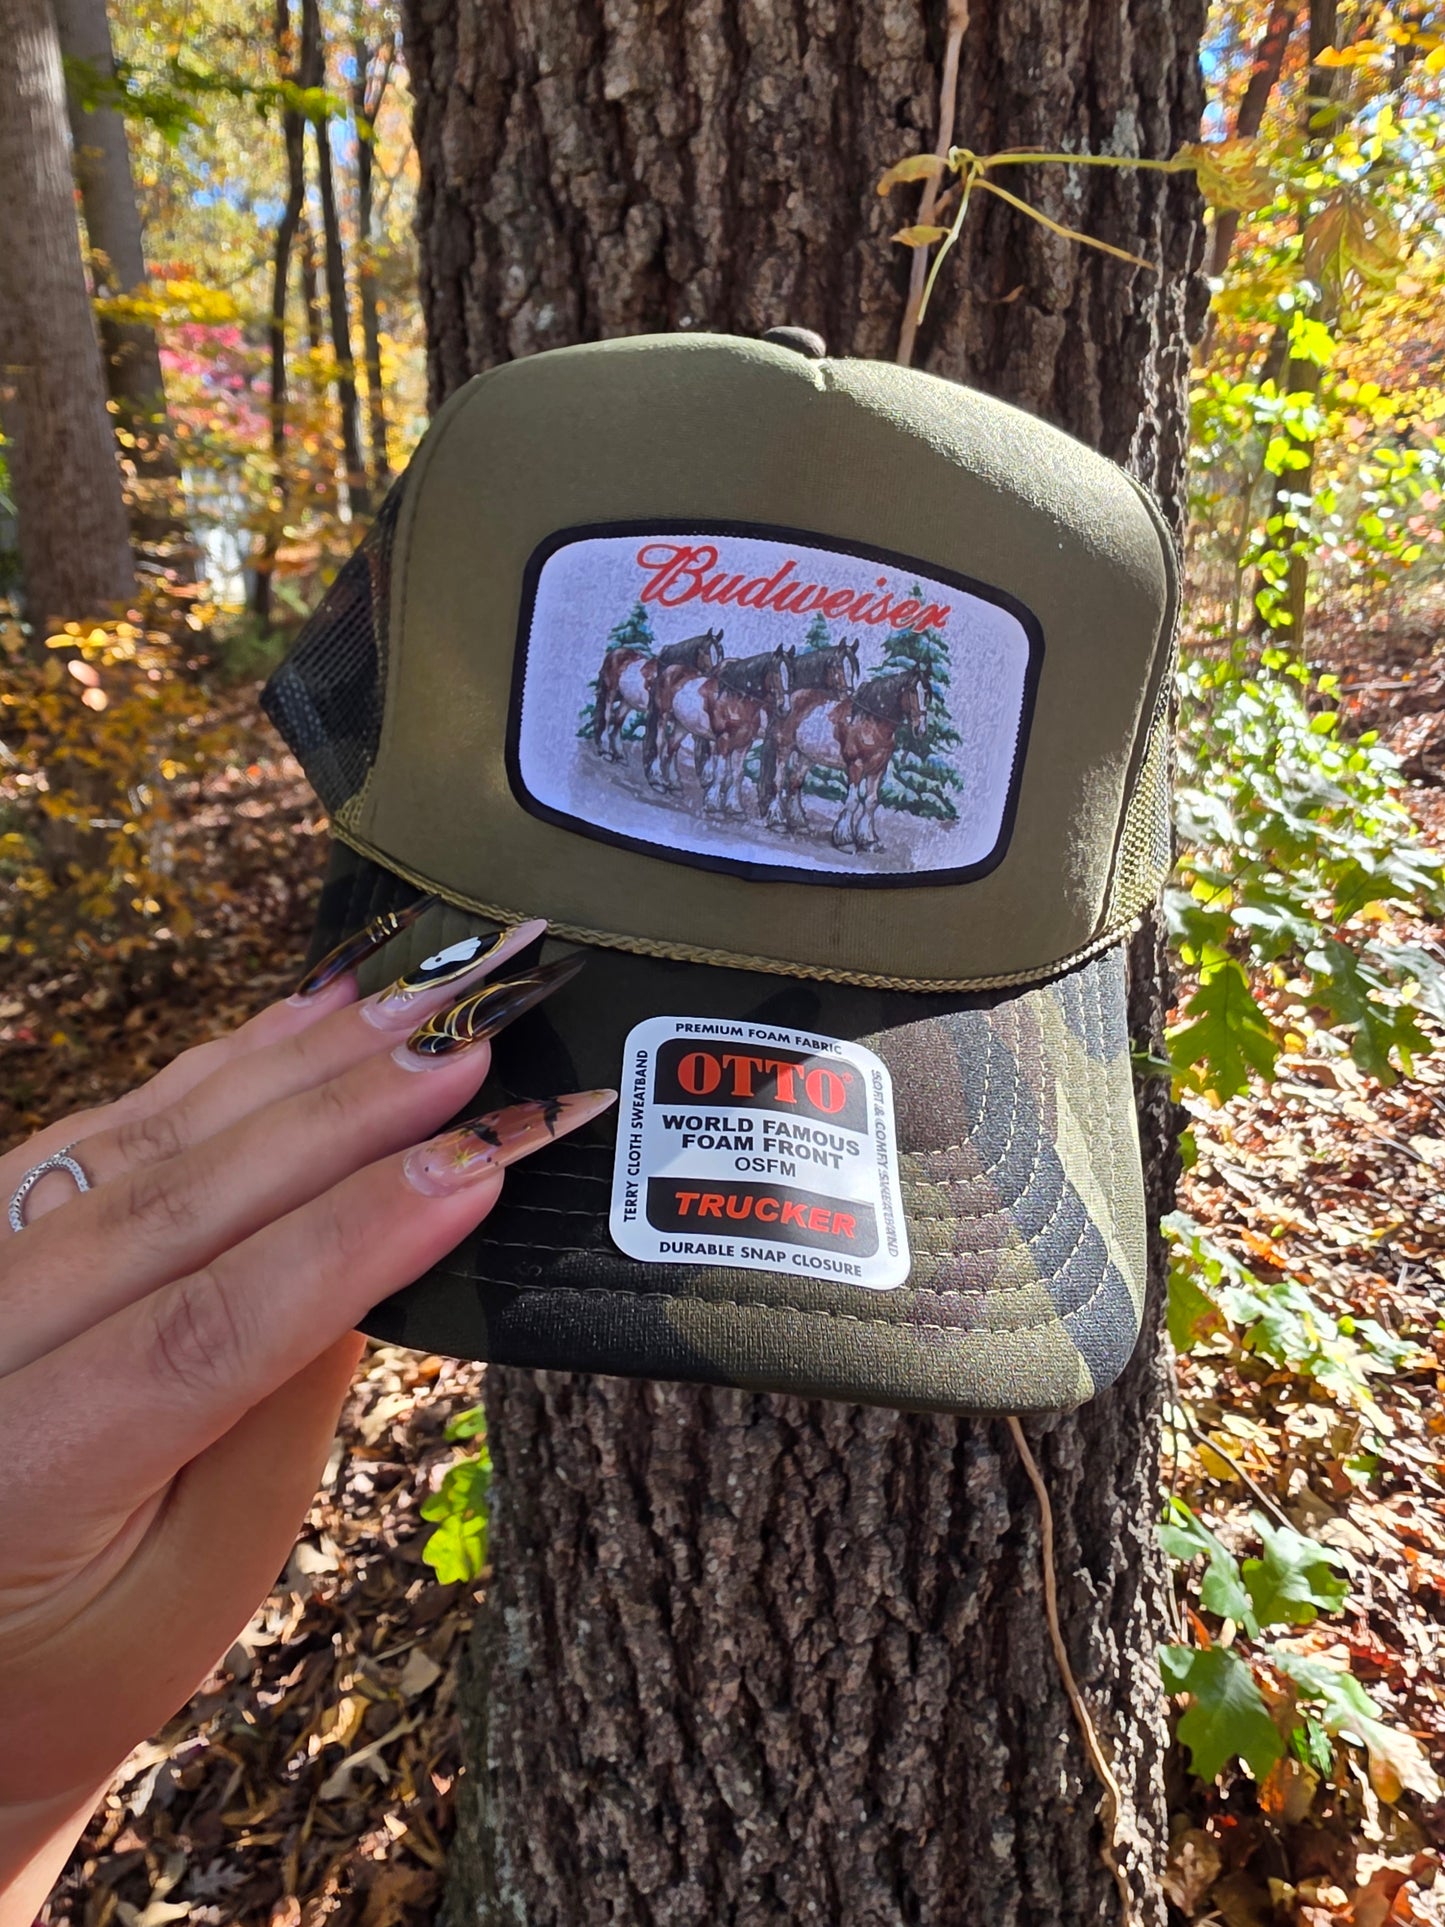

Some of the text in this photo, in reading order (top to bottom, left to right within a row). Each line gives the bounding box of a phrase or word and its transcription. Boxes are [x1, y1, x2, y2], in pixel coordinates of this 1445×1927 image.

[636, 543, 952, 633] Budweiser
[675, 1022, 842, 1055] PREMIUM FOAM FABRIC
[623, 1049, 648, 1222] TERRY CLOTH SWEATBAND
[662, 1115, 860, 1156] WORLD FAMOUS
[681, 1134, 843, 1170] FOAM FRONT
[735, 1157, 796, 1177] OSFM
[871, 1069, 899, 1257] SOFT & COMFY SWEATBAND
[675, 1191, 856, 1238] TRUCKER
[659, 1241, 862, 1277] DURABLE SNAP CLOSURE
